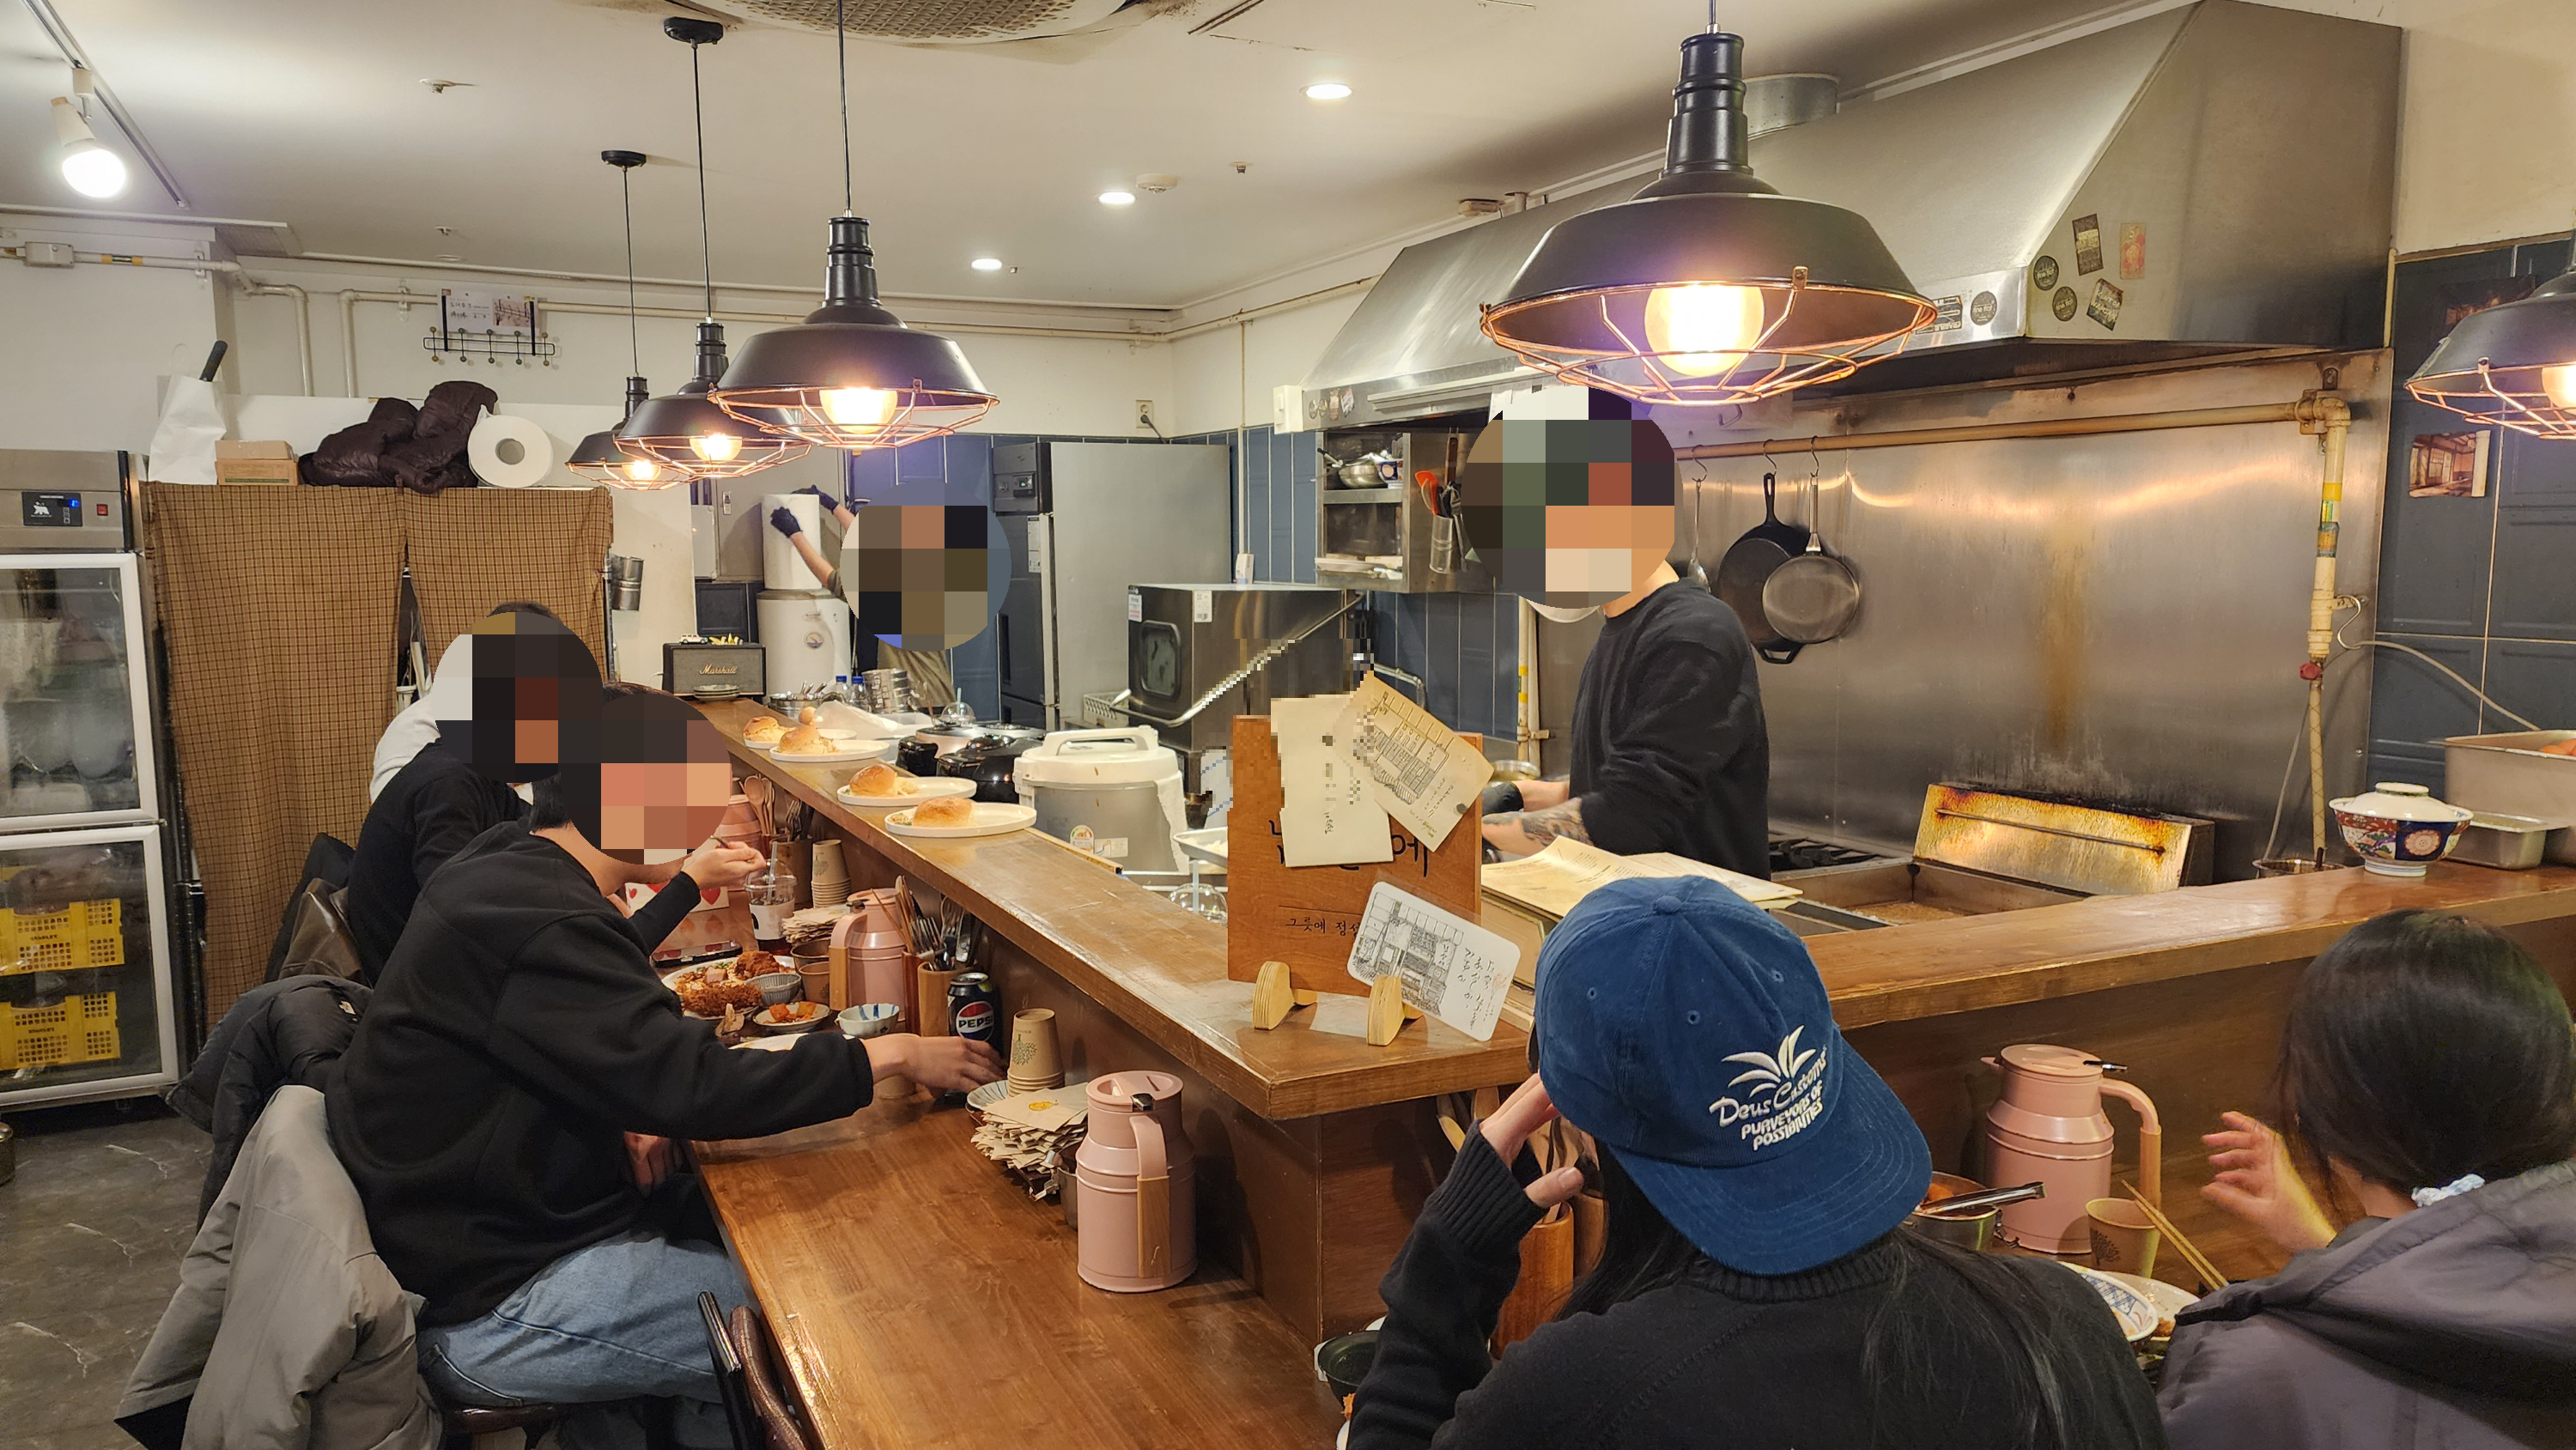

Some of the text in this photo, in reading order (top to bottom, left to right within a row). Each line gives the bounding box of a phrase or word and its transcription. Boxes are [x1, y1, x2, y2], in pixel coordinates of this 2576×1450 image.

[699, 664, 738, 675] Marshall
[1285, 916, 1327, 935] 그릇에
[1709, 1096, 1771, 1127] Deus
[1741, 1093, 1810, 1140] PURVEYORS
[1753, 1097, 1824, 1151] POSSIBILITIES
